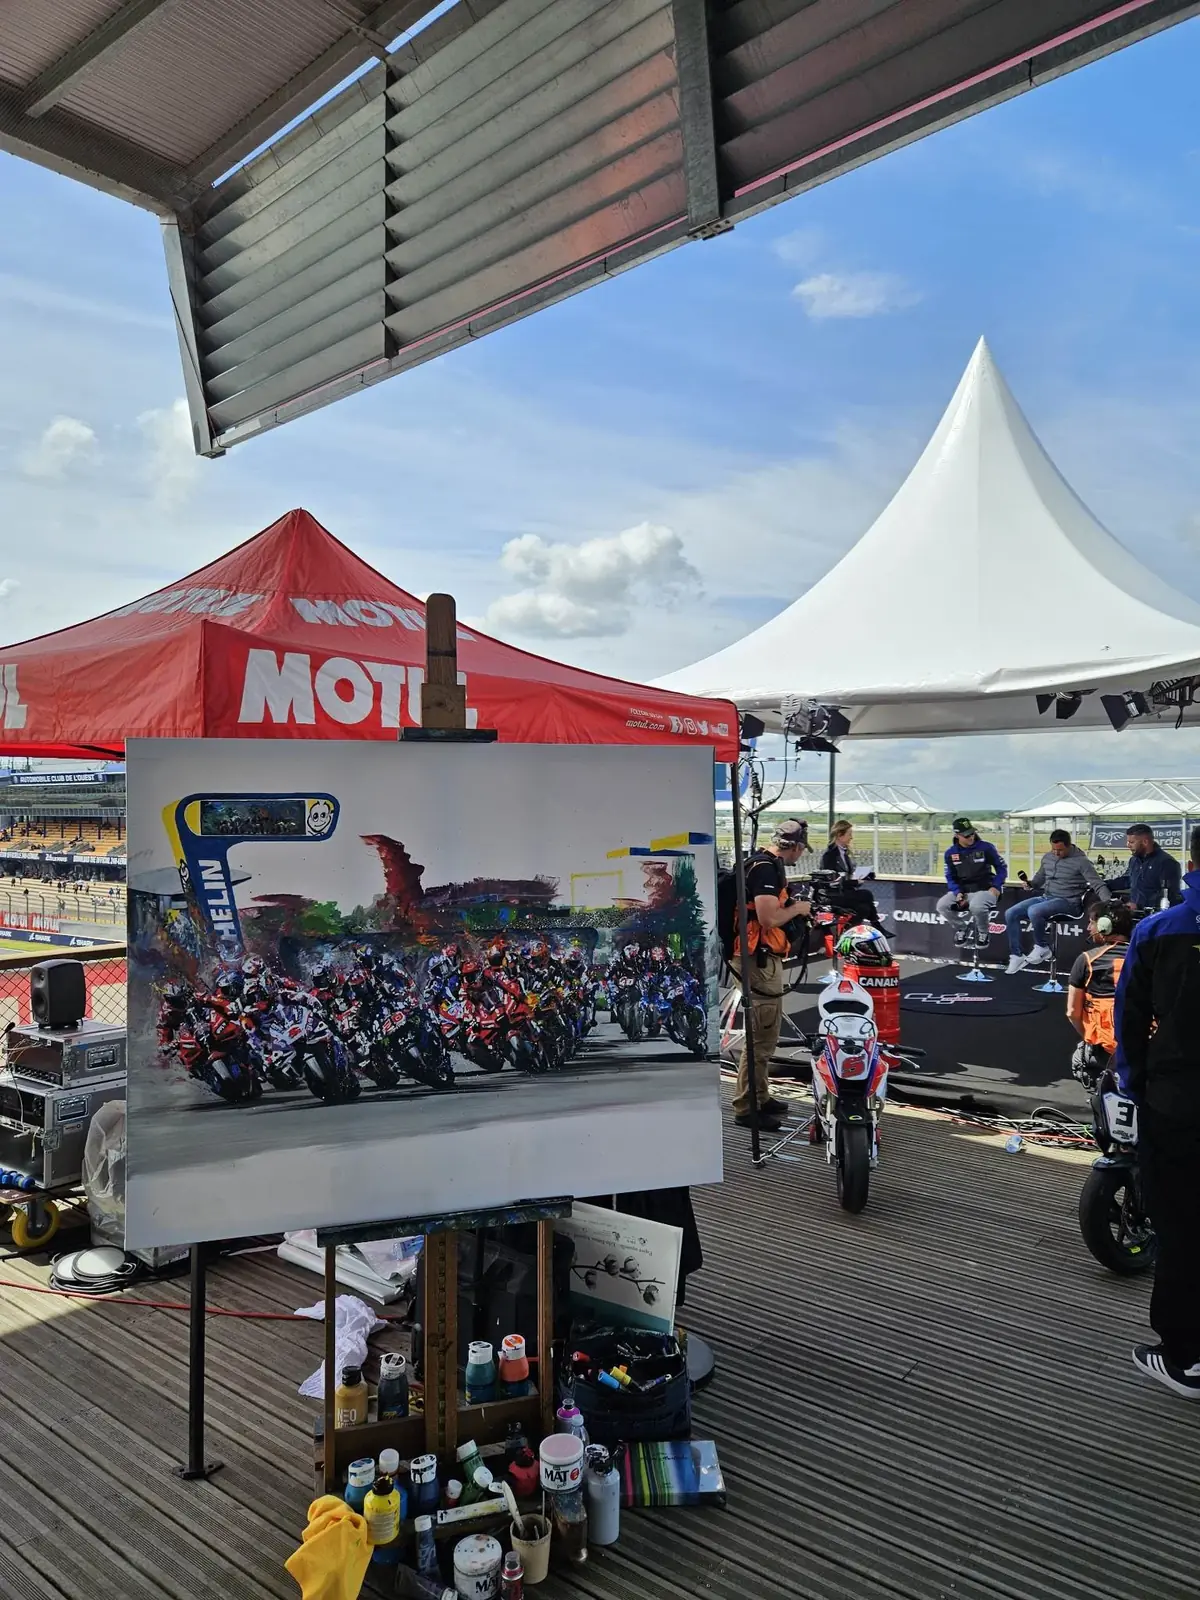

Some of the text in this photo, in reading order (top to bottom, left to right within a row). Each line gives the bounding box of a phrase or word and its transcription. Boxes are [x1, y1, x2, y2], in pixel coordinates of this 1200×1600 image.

[289, 598, 477, 642] MOT
[626, 719, 665, 731] motul.com
[74, 773, 95, 781] L'OUEST
[893, 909, 949, 925] CANAL+
[77, 939, 93, 947] SHARK
[859, 976, 899, 988] CANAL+
[1115, 1101, 1135, 1128] 3
[337, 1407, 357, 1423] NEO
[544, 1467, 570, 1483] MAT
